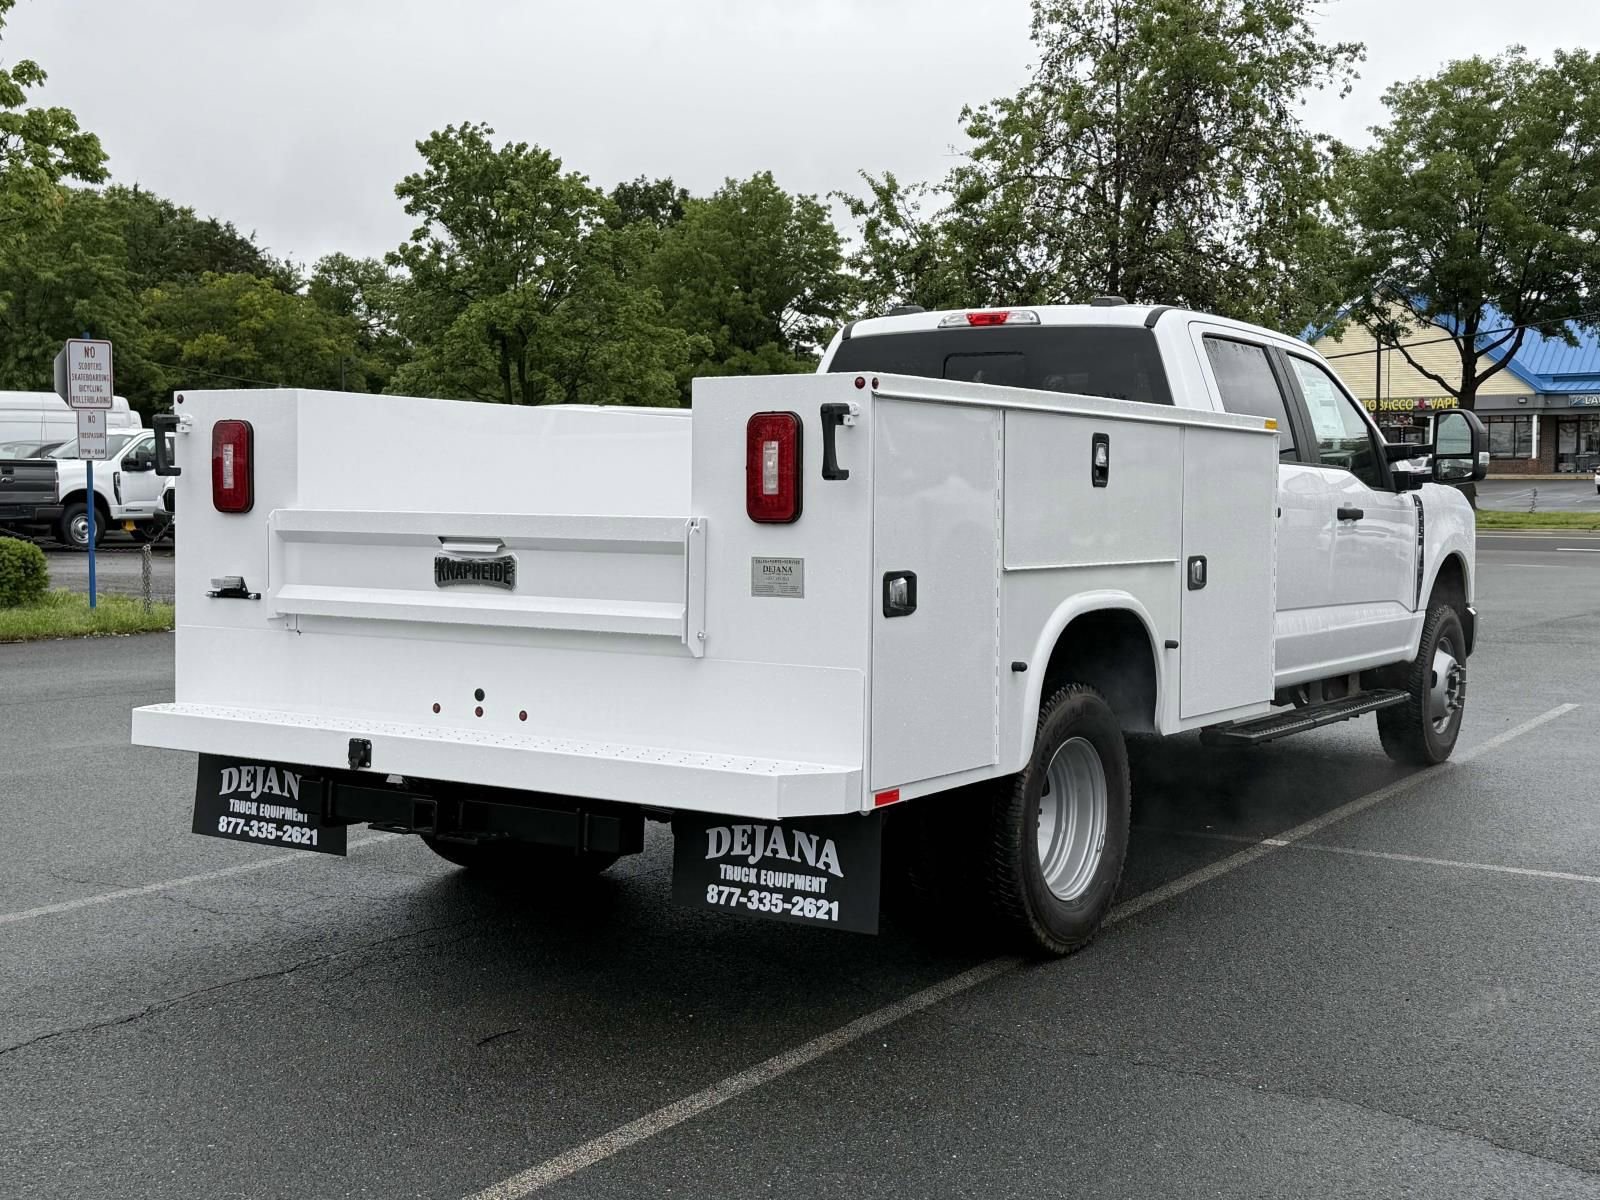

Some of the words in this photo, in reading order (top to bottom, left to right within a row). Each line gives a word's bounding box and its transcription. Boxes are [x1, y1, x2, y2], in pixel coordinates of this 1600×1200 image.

[84, 346, 95, 359] NO
[78, 362, 102, 371] SCOOTERS
[72, 373, 110, 382] SKATEBOARDING
[79, 384, 103, 393] BICYCLING
[1363, 399, 1414, 411] TOBACCO
[1430, 397, 1459, 409] VAPE
[1585, 396, 1600, 406] LA
[88, 415, 96, 424] NO
[436, 556, 513, 586] KNAPHEIDE
[763, 565, 792, 574] DEJANA
[219, 765, 302, 800] DEJAN
[229, 799, 257, 815] TRUCK
[218, 816, 318, 846] 877-335-2621
[705, 824, 844, 877] DEJANA
[719, 863, 757, 884] TRUCK
[760, 869, 828, 893] EQUIPMENT
[706, 884, 839, 922] 877-335-2621
